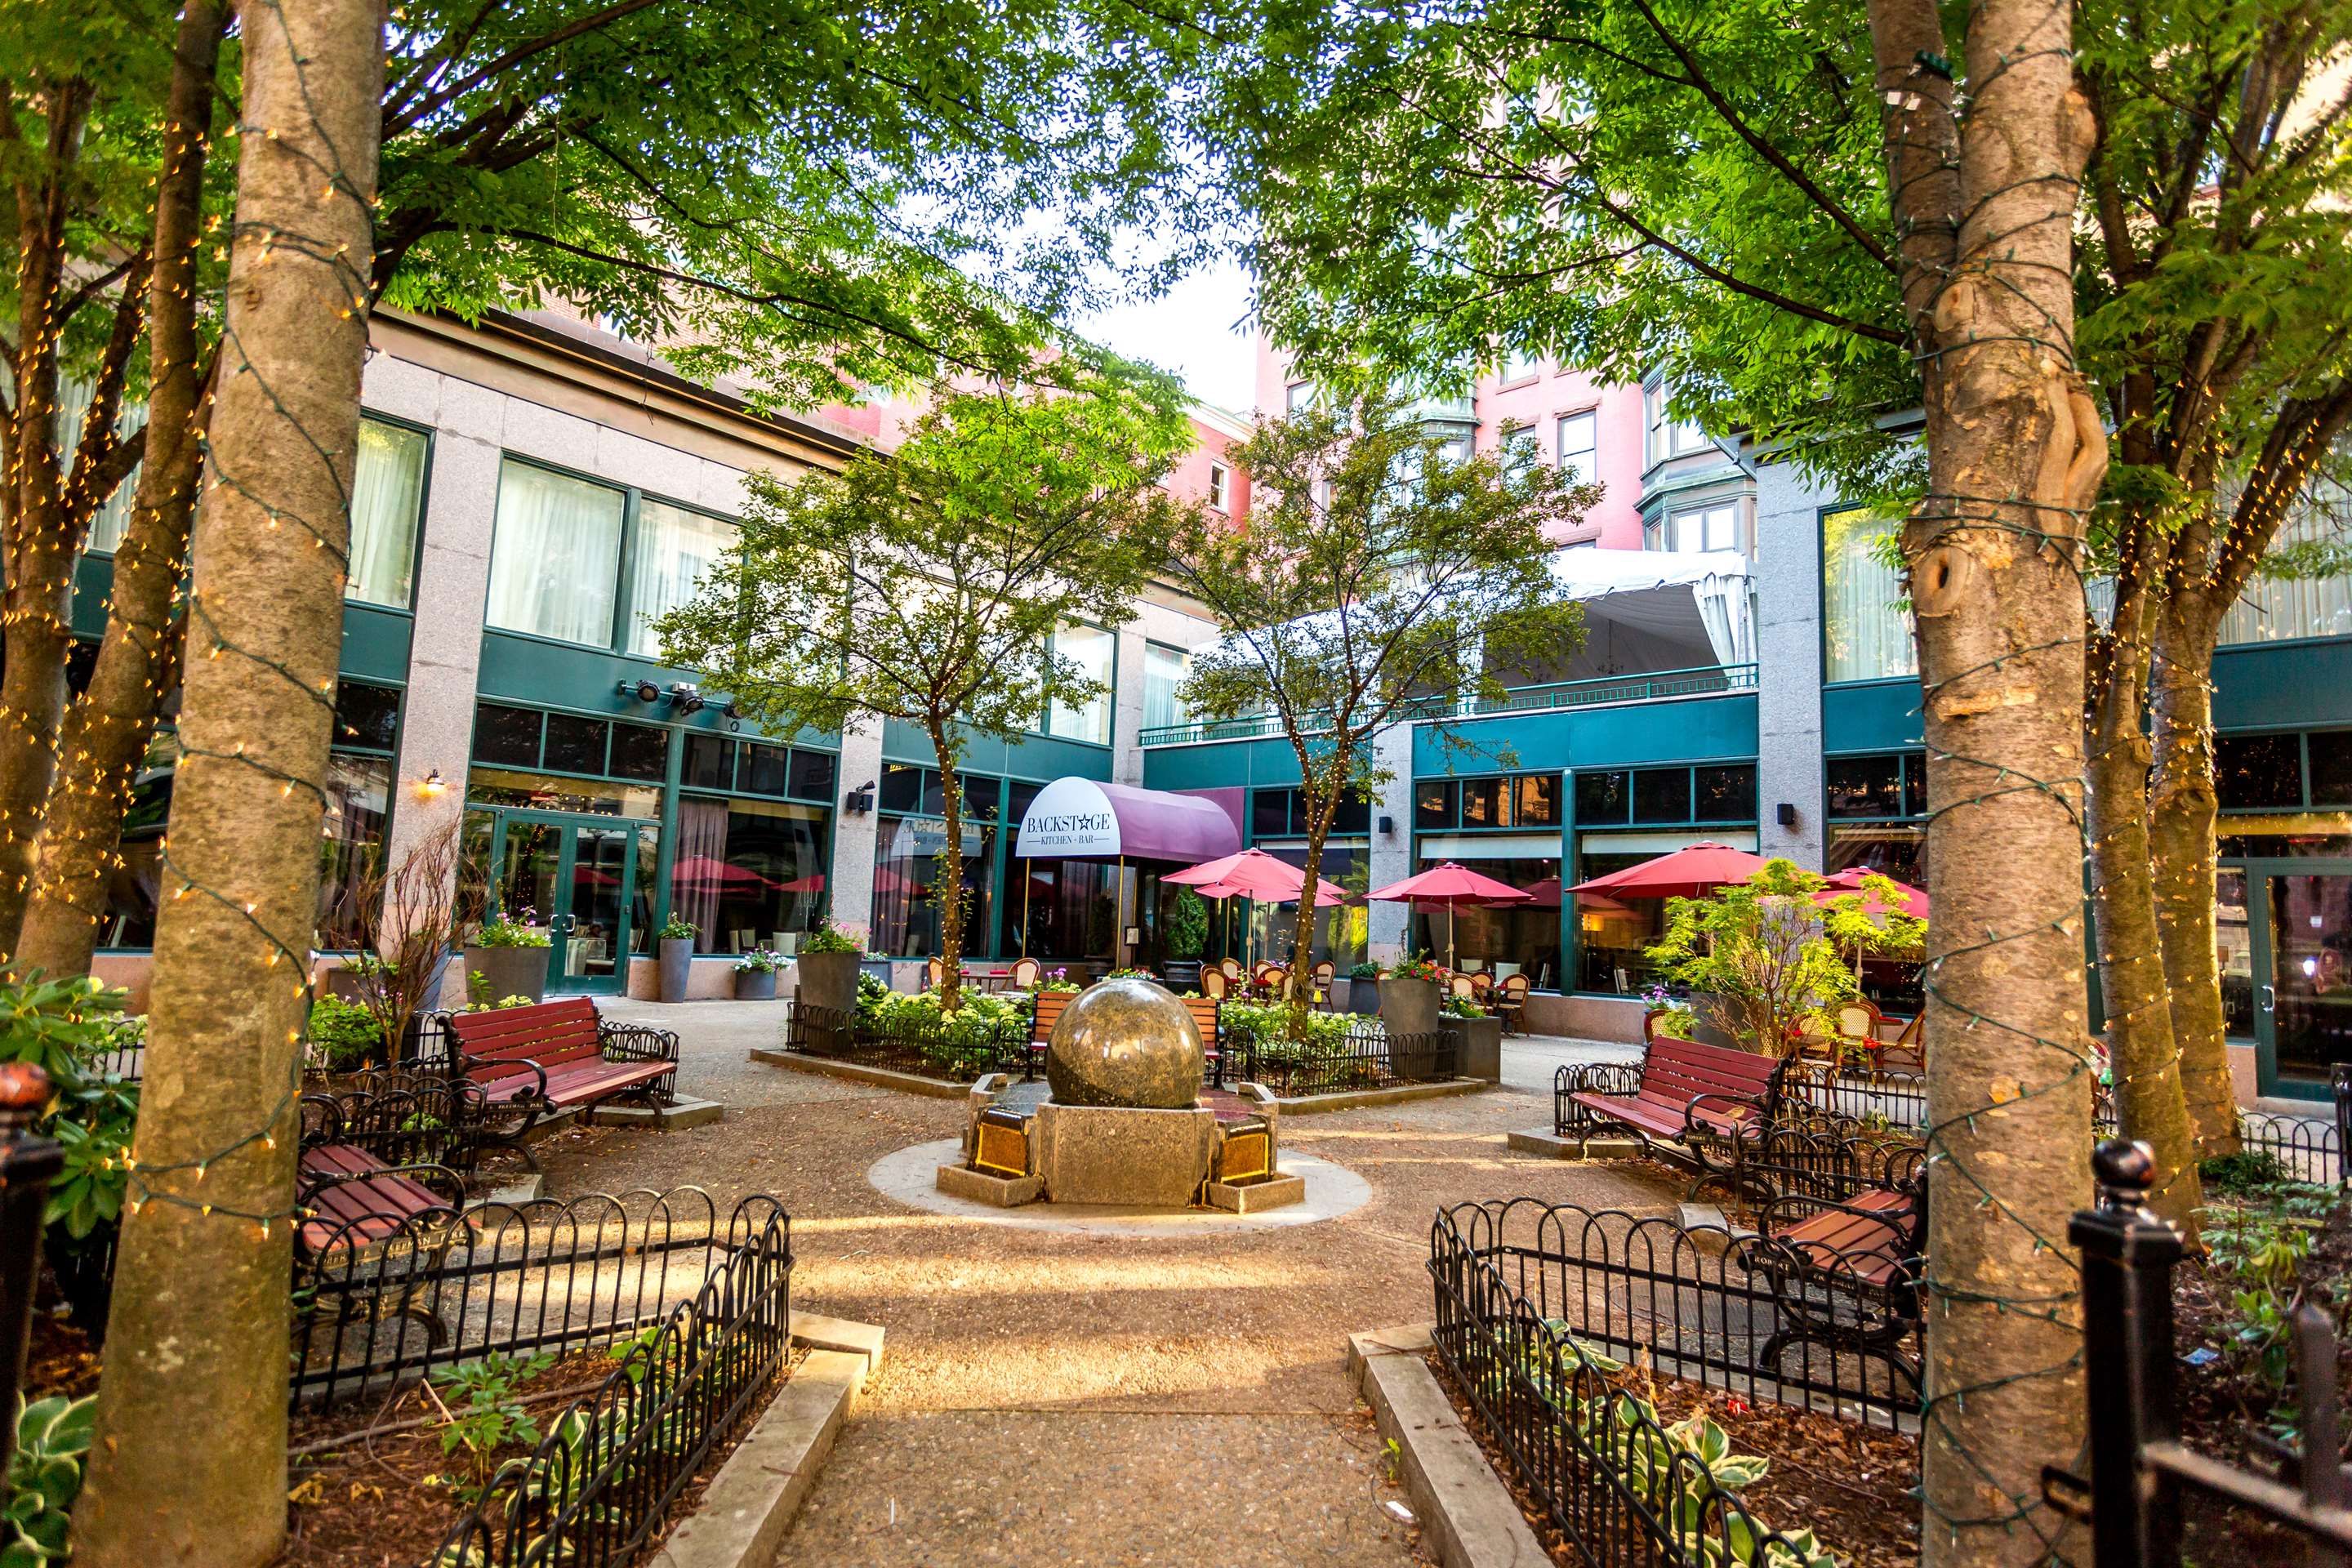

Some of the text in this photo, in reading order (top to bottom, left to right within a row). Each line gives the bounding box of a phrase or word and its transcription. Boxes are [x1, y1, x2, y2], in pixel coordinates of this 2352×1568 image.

[1040, 835, 1072, 845] KITCHEN
[1078, 835, 1094, 844] BAR
[440, 1229, 466, 1242] PRK
[1754, 1254, 1790, 1272] ROBRT
